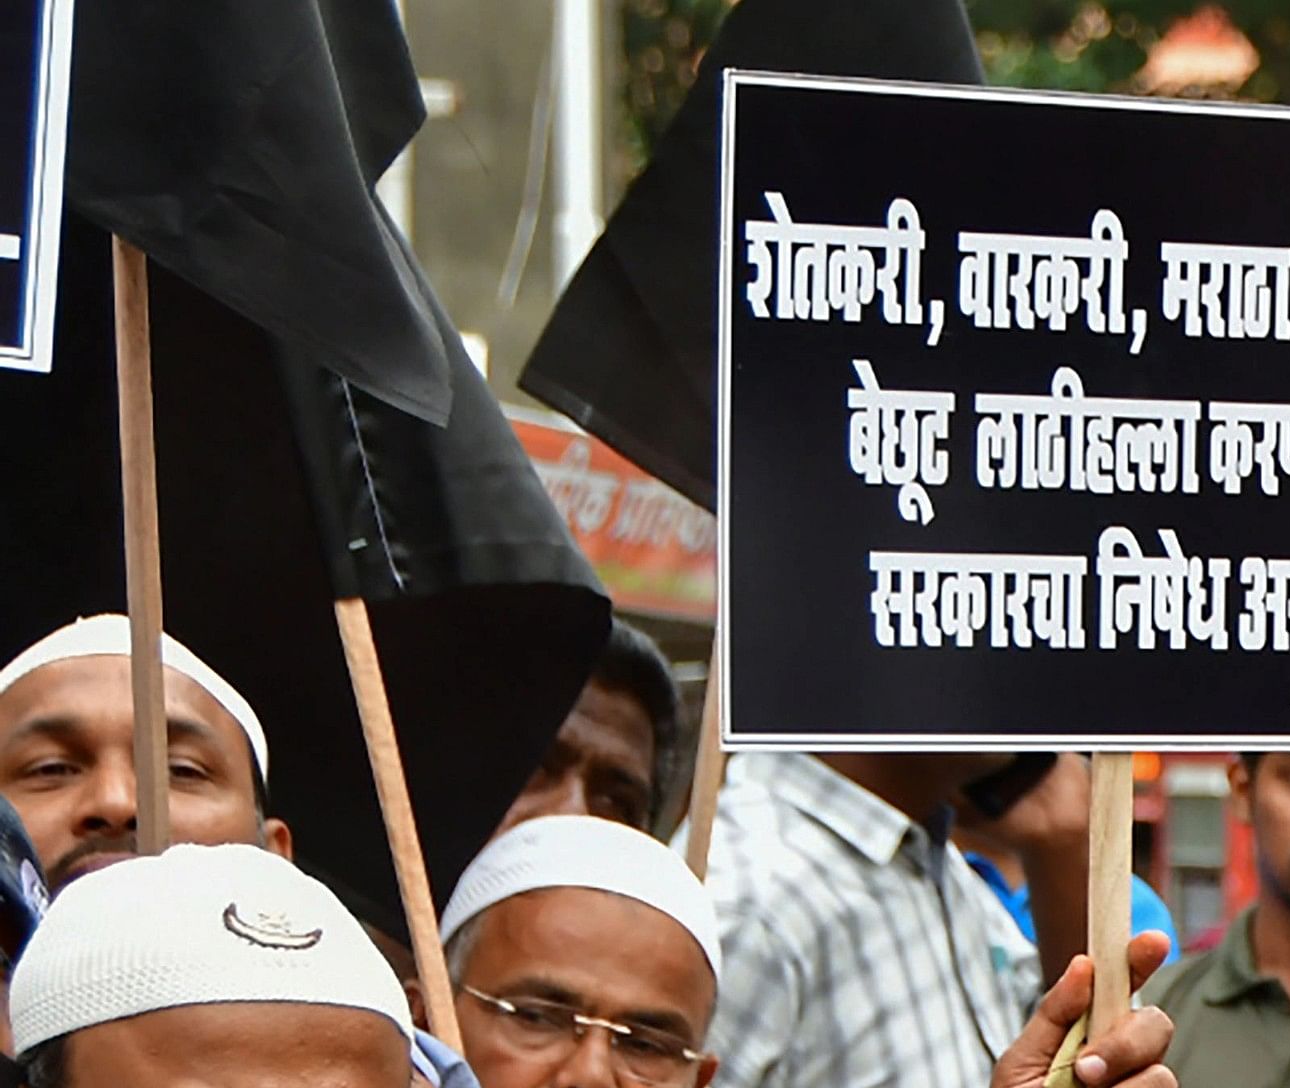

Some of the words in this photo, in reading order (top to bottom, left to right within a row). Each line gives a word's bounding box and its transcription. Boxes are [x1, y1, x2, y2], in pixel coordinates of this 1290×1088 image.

[746, 192, 944, 346] शेतकरी,
[959, 210, 1146, 355] वारकरी,
[848, 360, 955, 525] बेछूट
[975, 367, 1201, 494] लाठीहल्ला
[870, 551, 1087, 649] सरकारचा
[1097, 527, 1230, 650] निषेध
